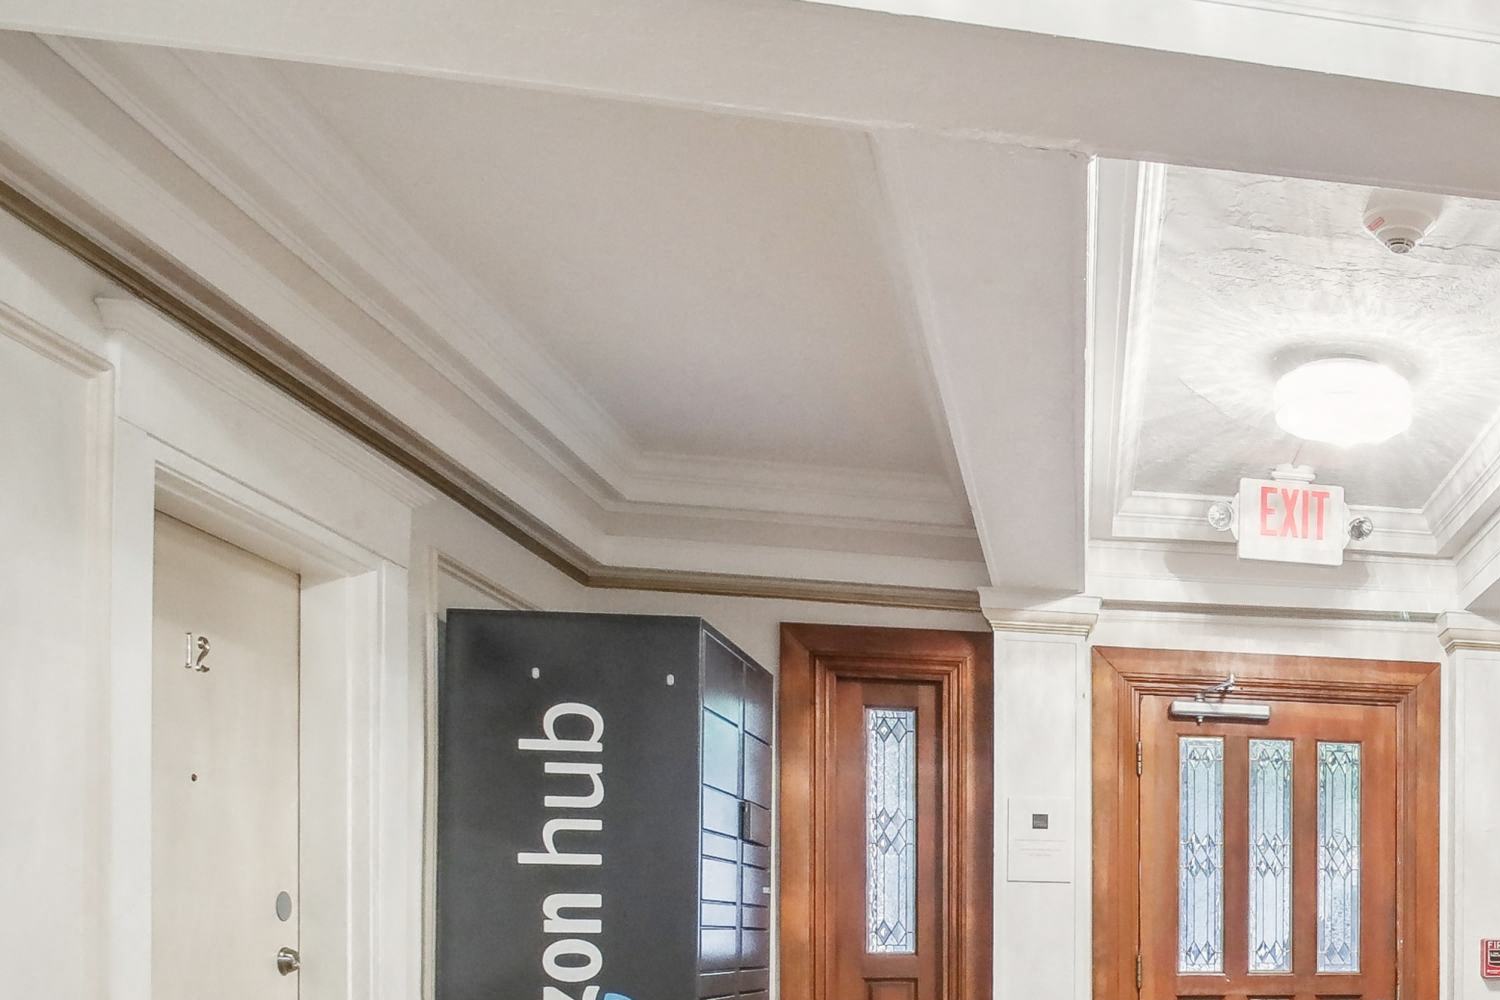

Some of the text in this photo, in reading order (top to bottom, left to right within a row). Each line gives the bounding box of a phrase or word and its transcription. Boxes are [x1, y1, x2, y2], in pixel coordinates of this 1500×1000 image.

[1260, 486, 1330, 540] EXIT
[184, 632, 210, 673] 12
[518, 703, 603, 865] hub
